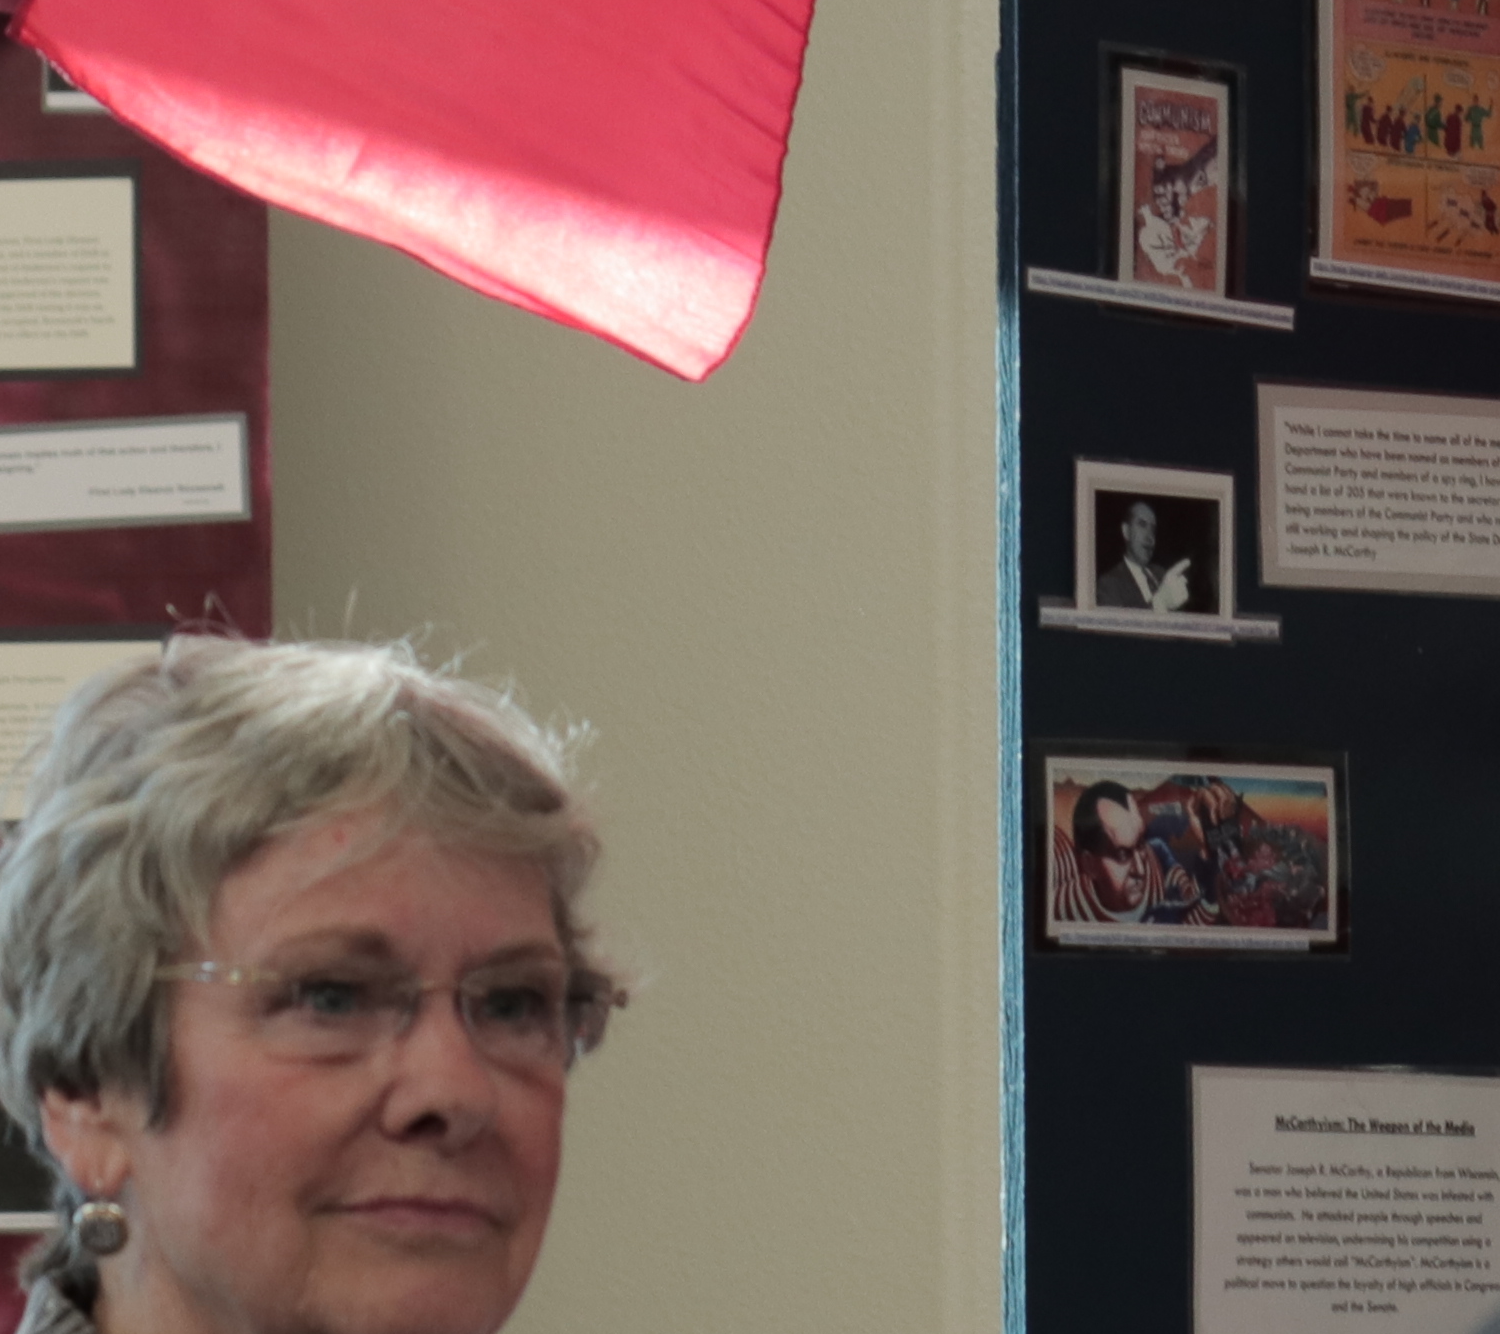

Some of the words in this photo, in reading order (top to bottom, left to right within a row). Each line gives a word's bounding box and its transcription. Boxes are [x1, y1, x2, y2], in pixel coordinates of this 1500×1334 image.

[1348, 1117, 1366, 1133] The
[1369, 1118, 1409, 1134] Weapon
[1426, 1119, 1441, 1135] the
[1445, 1120, 1476, 1136] Media
